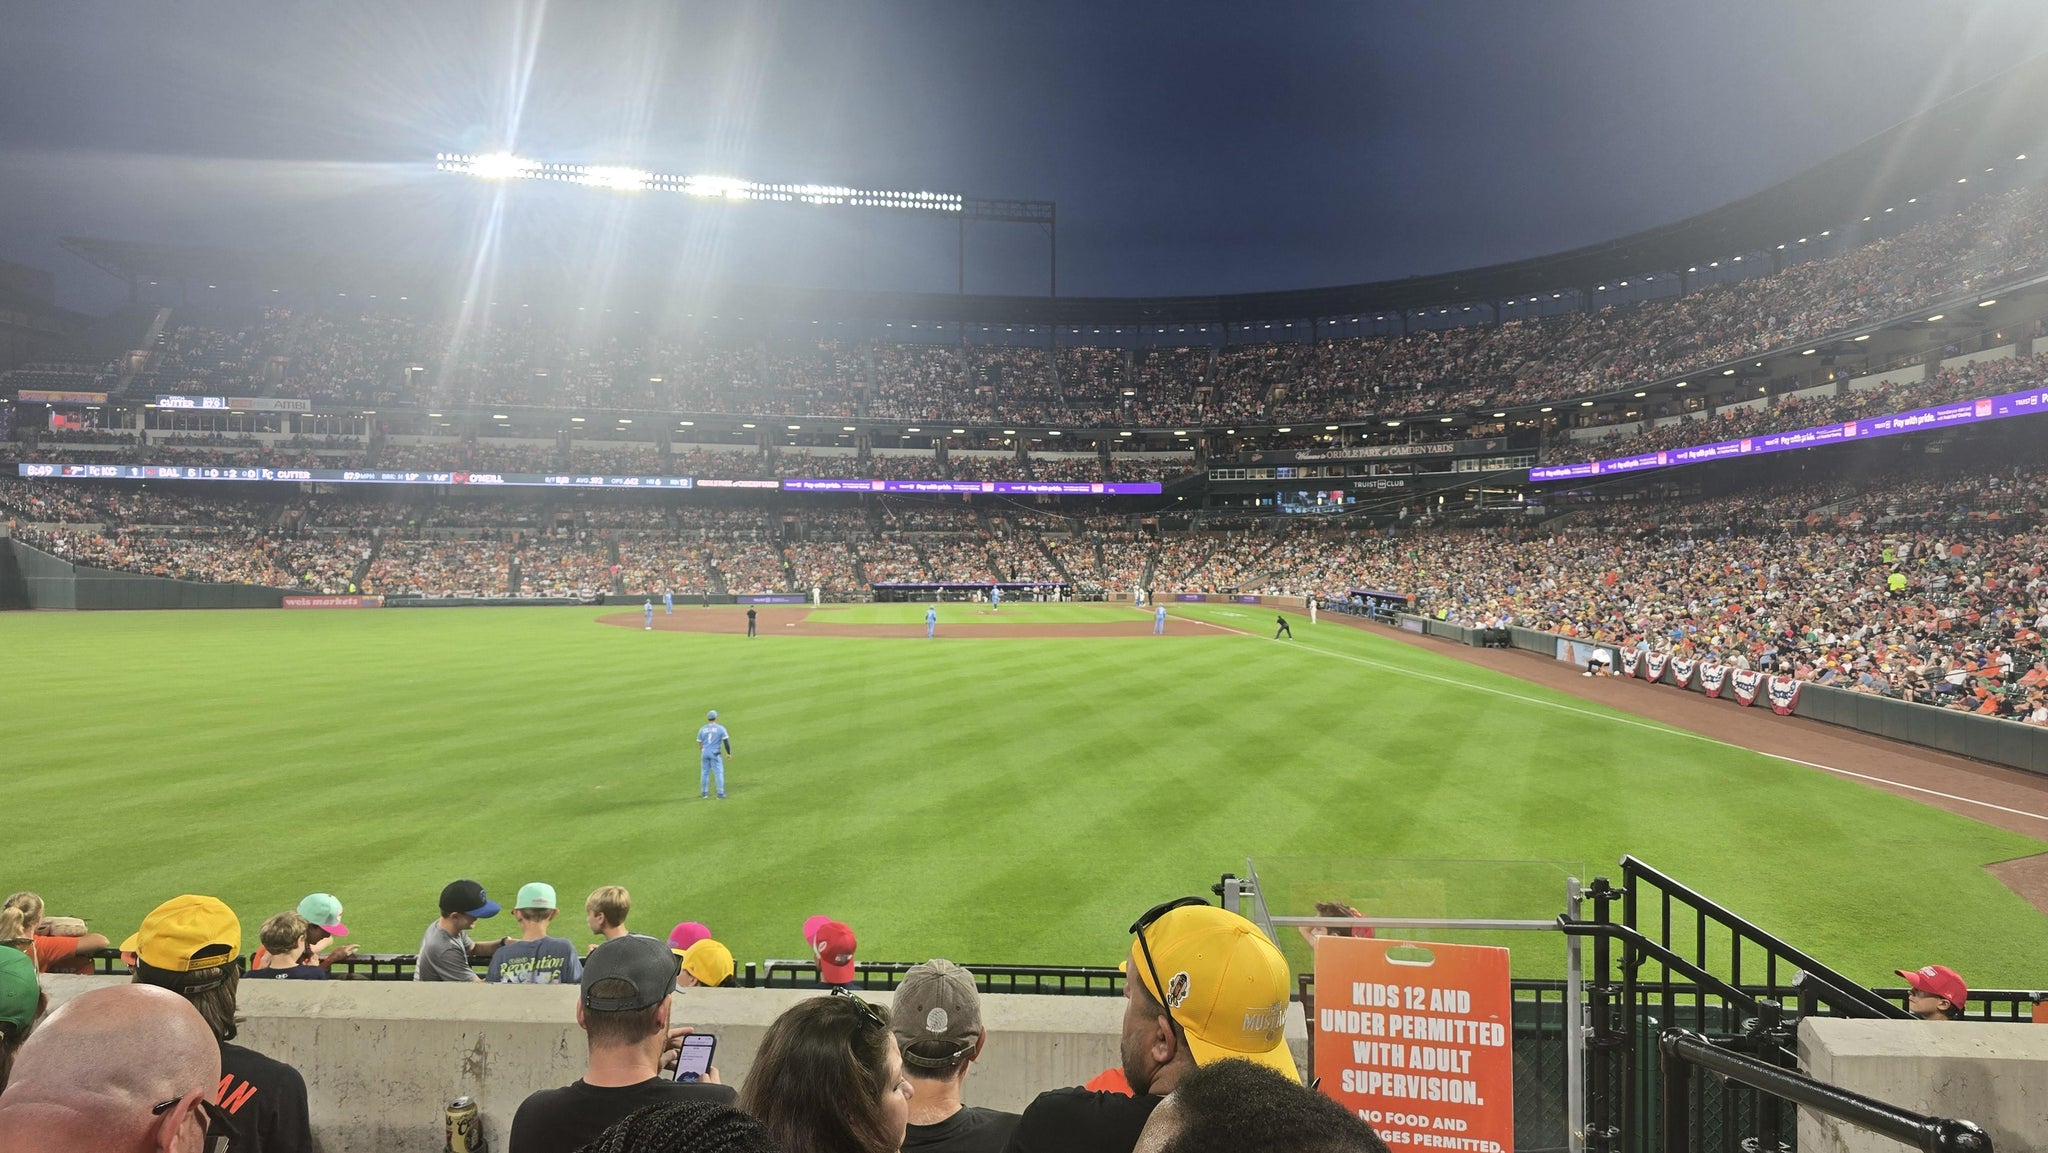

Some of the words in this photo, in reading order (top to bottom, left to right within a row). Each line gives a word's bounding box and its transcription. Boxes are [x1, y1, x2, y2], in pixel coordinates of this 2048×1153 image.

[160, 399, 194, 407] CUTTER
[1893, 418, 1904, 428] Pay
[1904, 416, 1918, 426] with
[1326, 450, 1359, 459] ORIOLE
[1359, 449, 1382, 458] PARK
[1389, 446, 1427, 456] CAMDEN
[1427, 444, 1454, 453] YARDS
[27, 465, 53, 476] 8:49
[101, 466, 118, 476] KC
[131, 467, 138, 476] 1
[159, 468, 180, 477] BAL
[228, 469, 237, 478] 2
[277, 471, 311, 479] CUTTER
[343, 472, 360, 480] 87.9
[286, 597, 311, 606] weis
[312, 597, 358, 606] markets
[500, 955, 564, 976] Revolution
[1352, 982, 1400, 1008] KIDS
[1404, 986, 1425, 1010] 12
[1430, 988, 1471, 1014] AND
[1320, 1008, 1385, 1037] UNDER
[1389, 1015, 1505, 1047] PERMITTED
[1352, 1040, 1405, 1068] WITH
[1409, 1045, 1472, 1074] ADULT
[1341, 1069, 1484, 1106] SUPERVISION.
[1358, 1109, 1382, 1123] NO
[1385, 1112, 1430, 1128] FOOD
[1432, 1117, 1468, 1132] AND
[1373, 1129, 1411, 1144] GES
[1413, 1134, 1506, 1153] PERMITTED.
